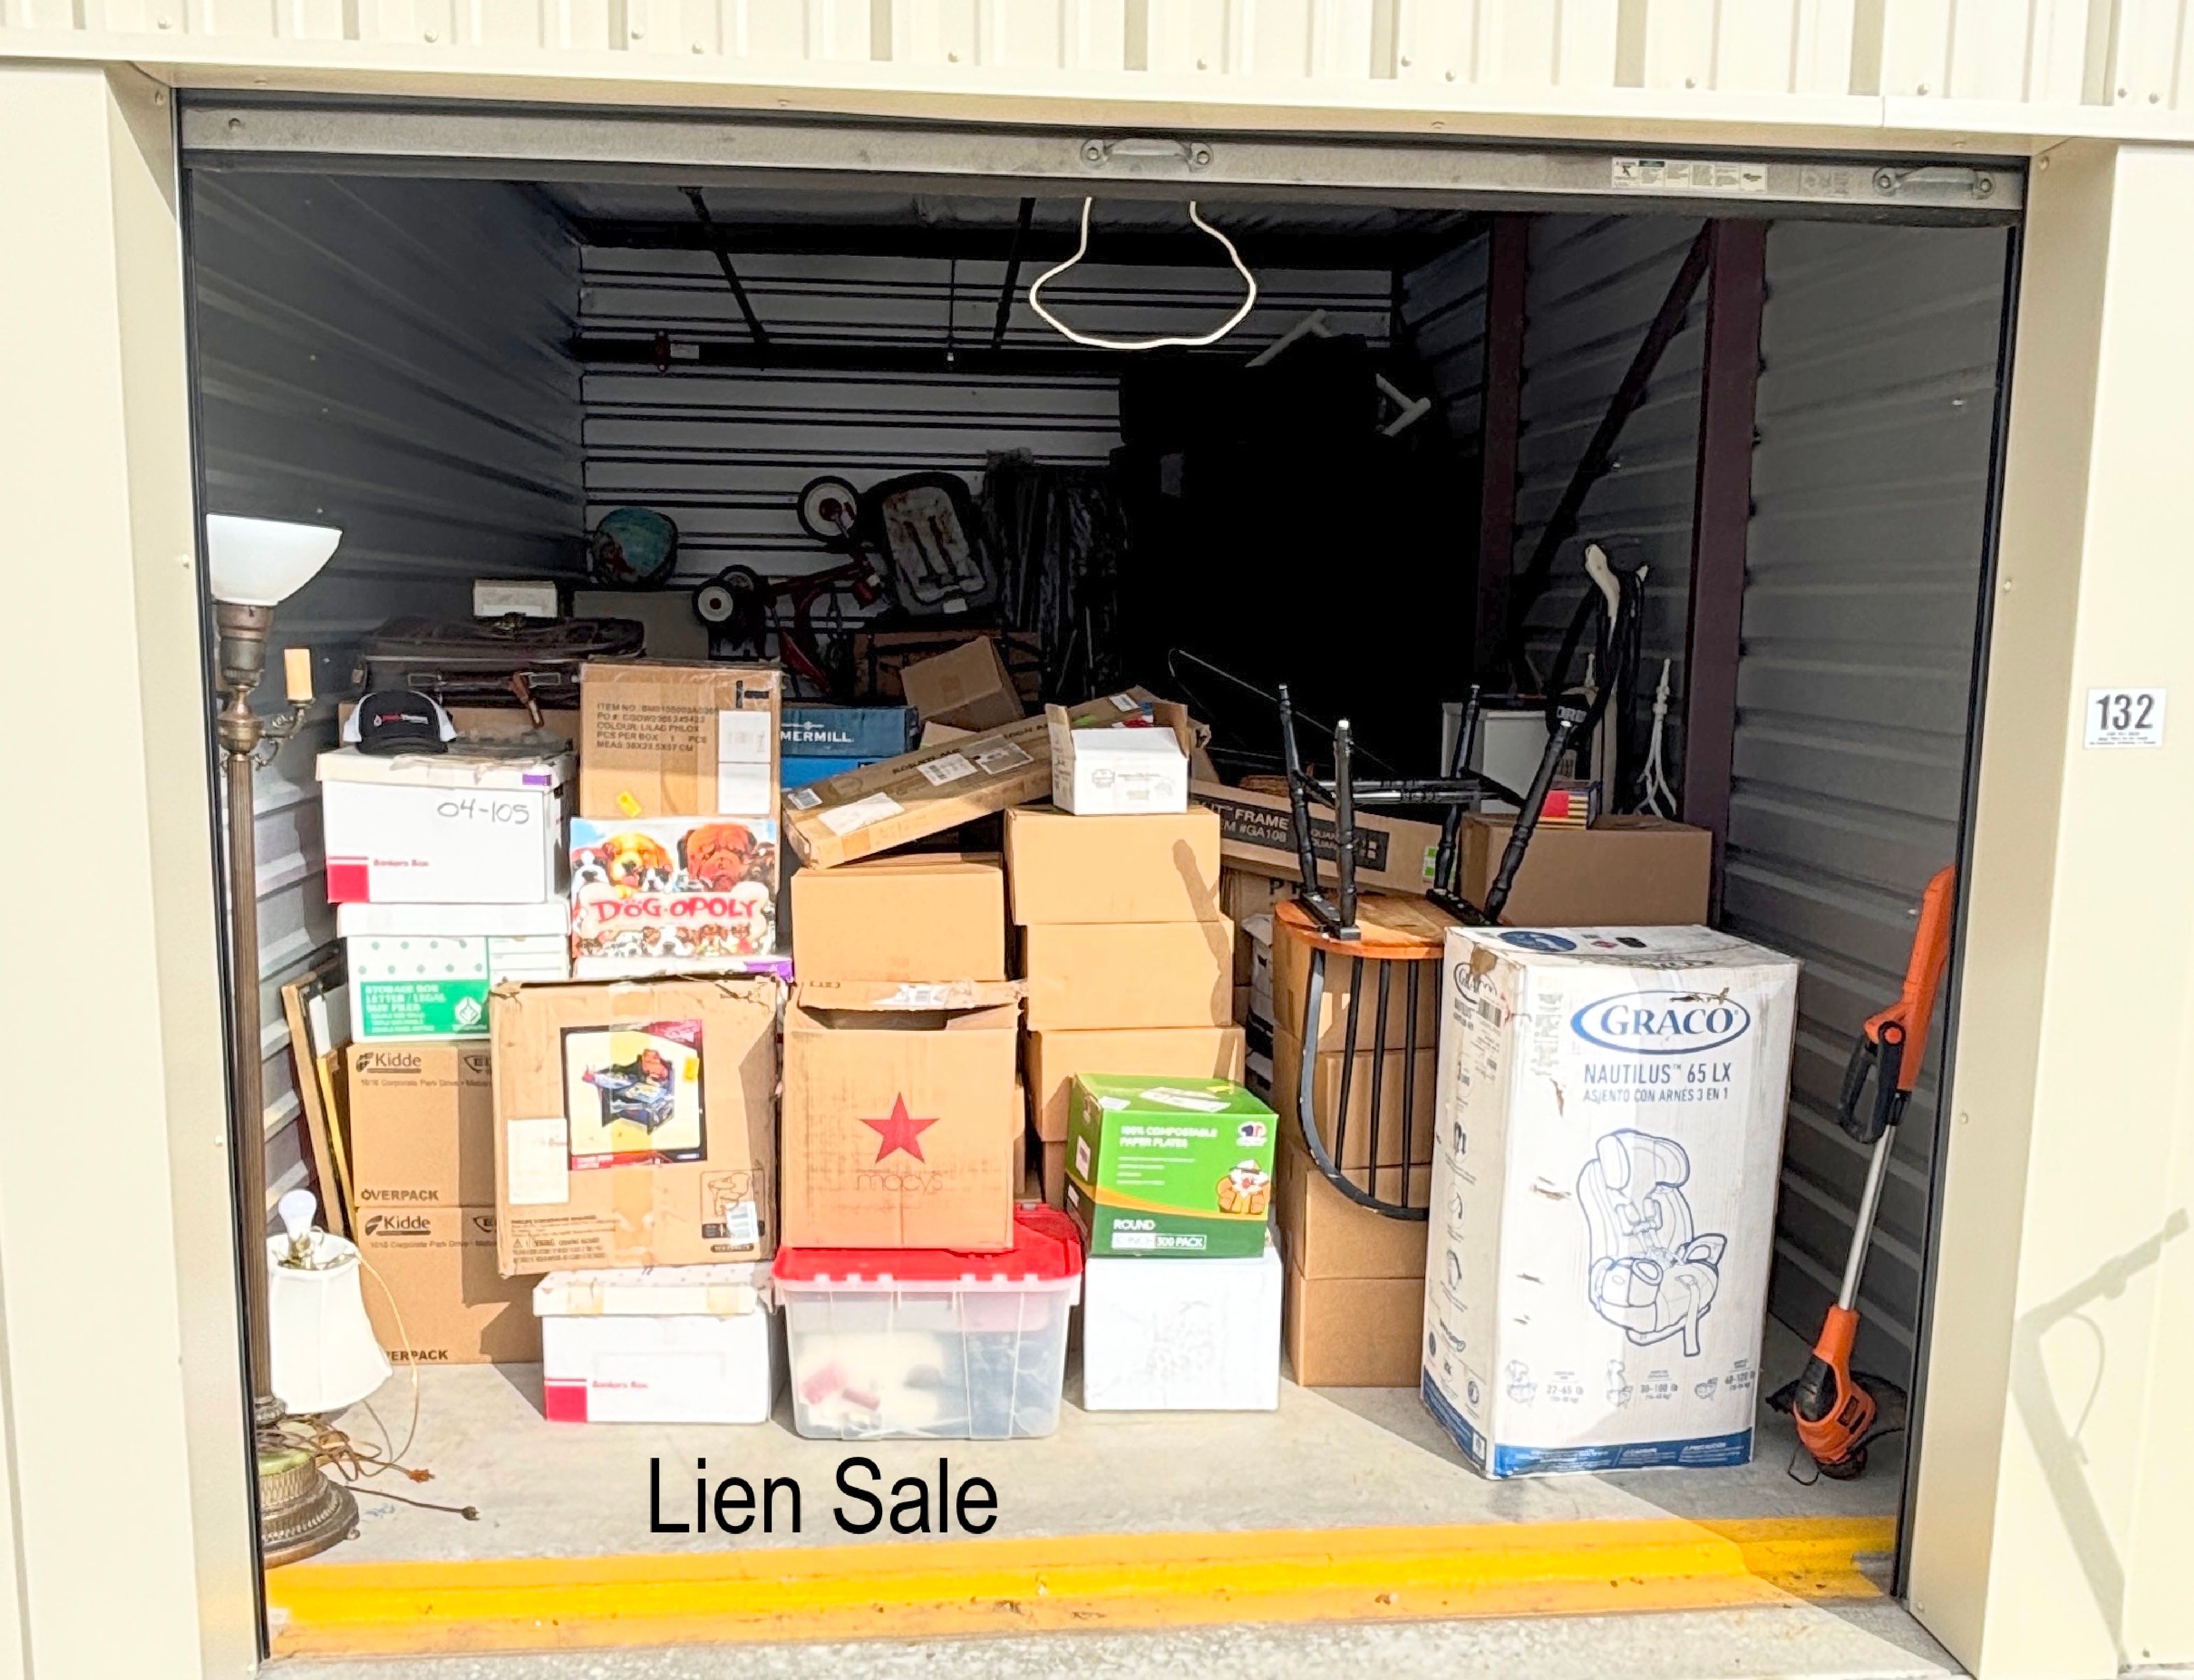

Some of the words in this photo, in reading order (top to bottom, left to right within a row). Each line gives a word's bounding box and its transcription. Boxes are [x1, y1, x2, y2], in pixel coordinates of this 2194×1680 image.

[2096, 694, 2155, 730] 132
[437, 799, 530, 824] 04-105
[1235, 809, 1289, 830] FRAME
[376, 1053, 422, 1067] Kidde
[1687, 1064, 1706, 1083] 65
[1713, 1062, 1731, 1082] LX
[1635, 1089, 1655, 1102] CON
[1697, 1089, 1703, 1100] 3
[1707, 1088, 1719, 1100] EN
[1724, 1087, 1728, 1099] 1
[1119, 1137, 1151, 1147] PAPER
[361, 1190, 439, 1201] OVERPACK
[384, 1216, 431, 1229] Kidde
[1113, 1219, 1155, 1230] ROUND
[1175, 1237, 1203, 1247] PACK
